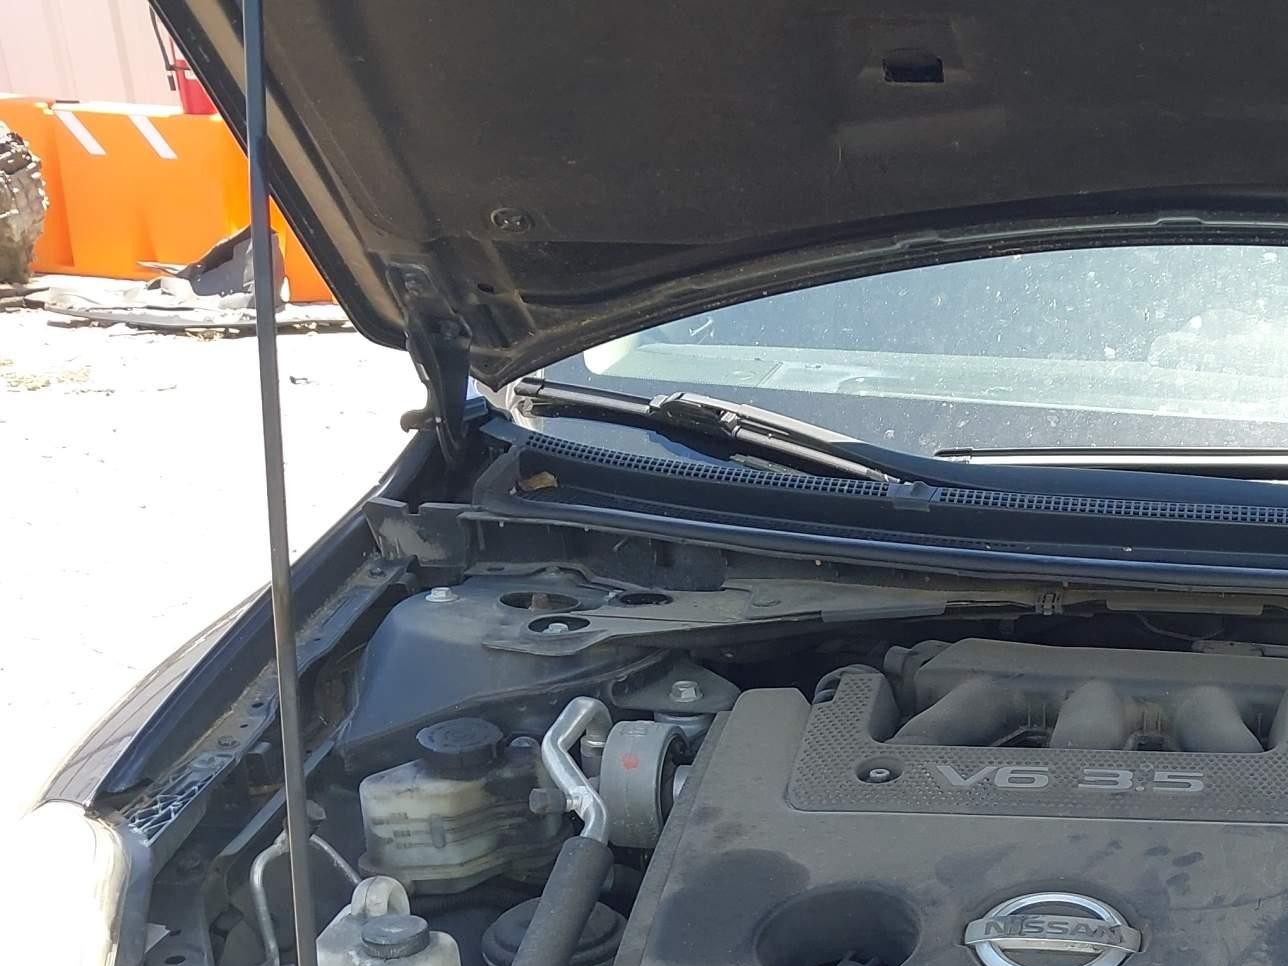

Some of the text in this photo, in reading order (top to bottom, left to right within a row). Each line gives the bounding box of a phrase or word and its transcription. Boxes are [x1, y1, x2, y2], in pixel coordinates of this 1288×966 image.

[936, 765, 1204, 792] V6 3.5
[983, 919, 1121, 944] NISSAN
